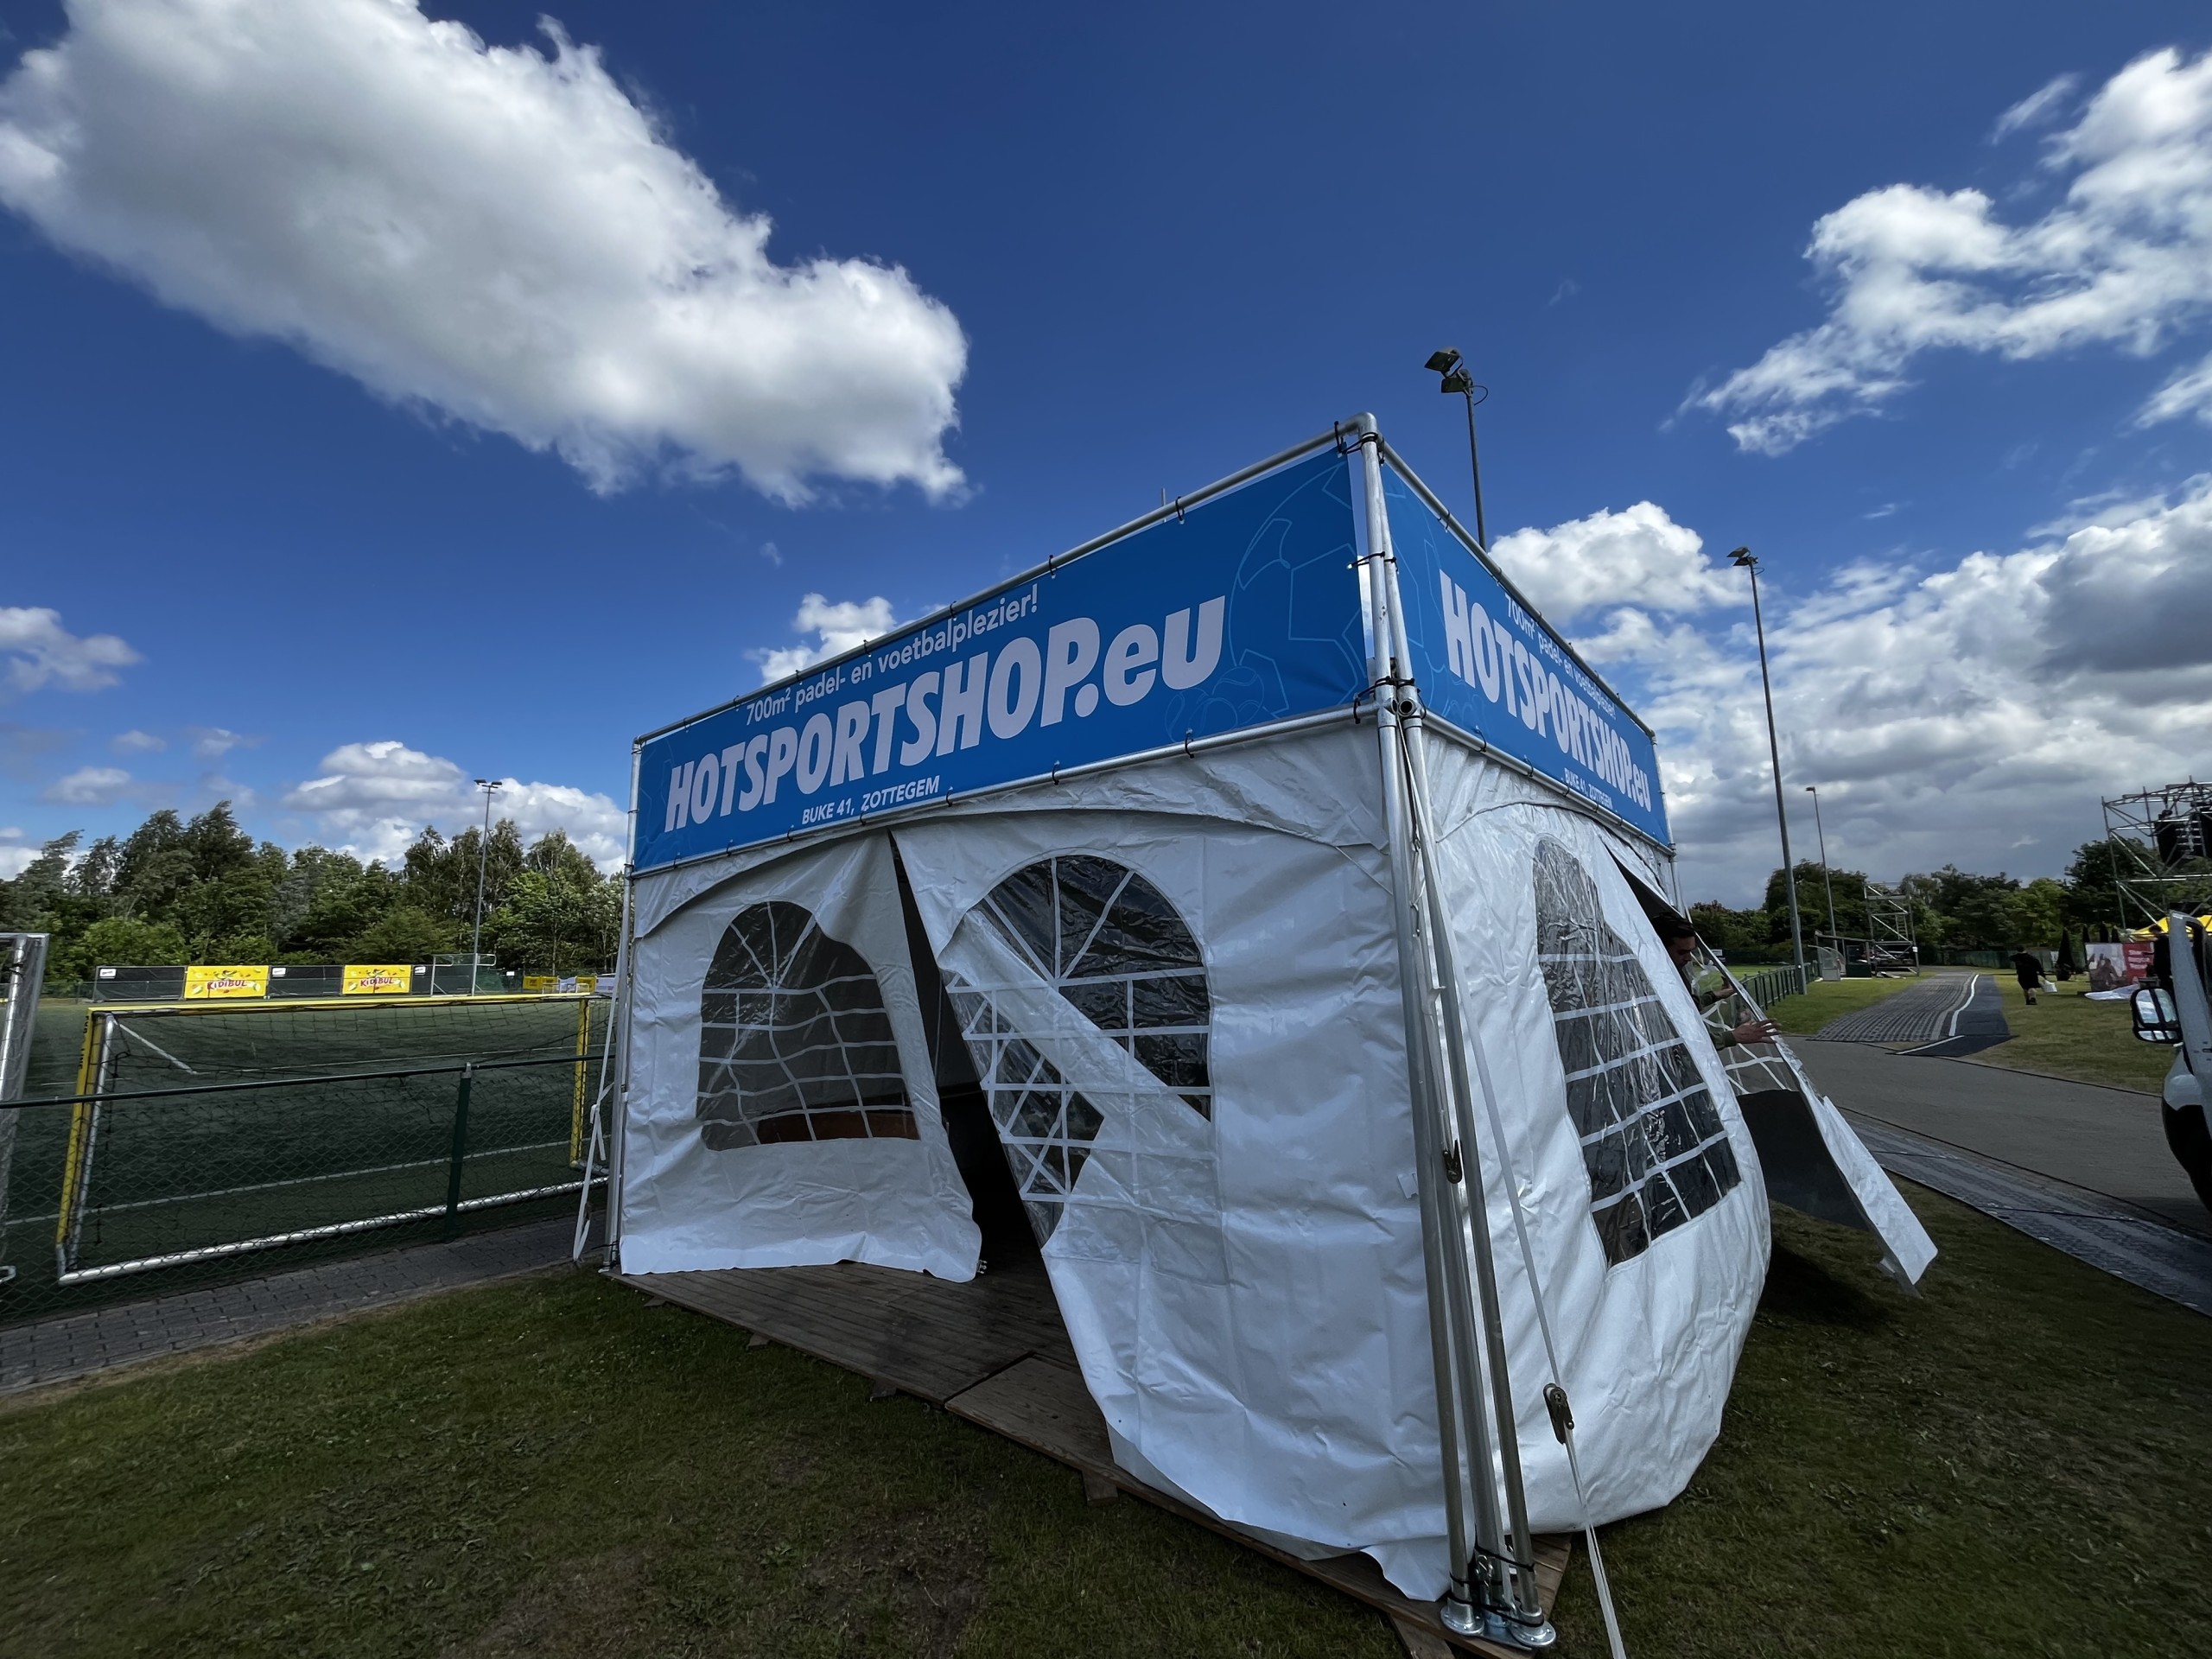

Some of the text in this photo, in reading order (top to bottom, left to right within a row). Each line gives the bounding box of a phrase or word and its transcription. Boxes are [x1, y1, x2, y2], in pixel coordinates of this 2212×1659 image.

[664, 594, 1225, 833] HOTSPORTSHOP.eu
[794, 665, 846, 713] padel-
[850, 661, 872, 684] en
[878, 583, 1037, 673] voetbalplezier!
[1440, 569, 1651, 812] HOTSPORTSHOP.eu
[802, 775, 940, 824] BUKE 41, ZOTTEGEM
